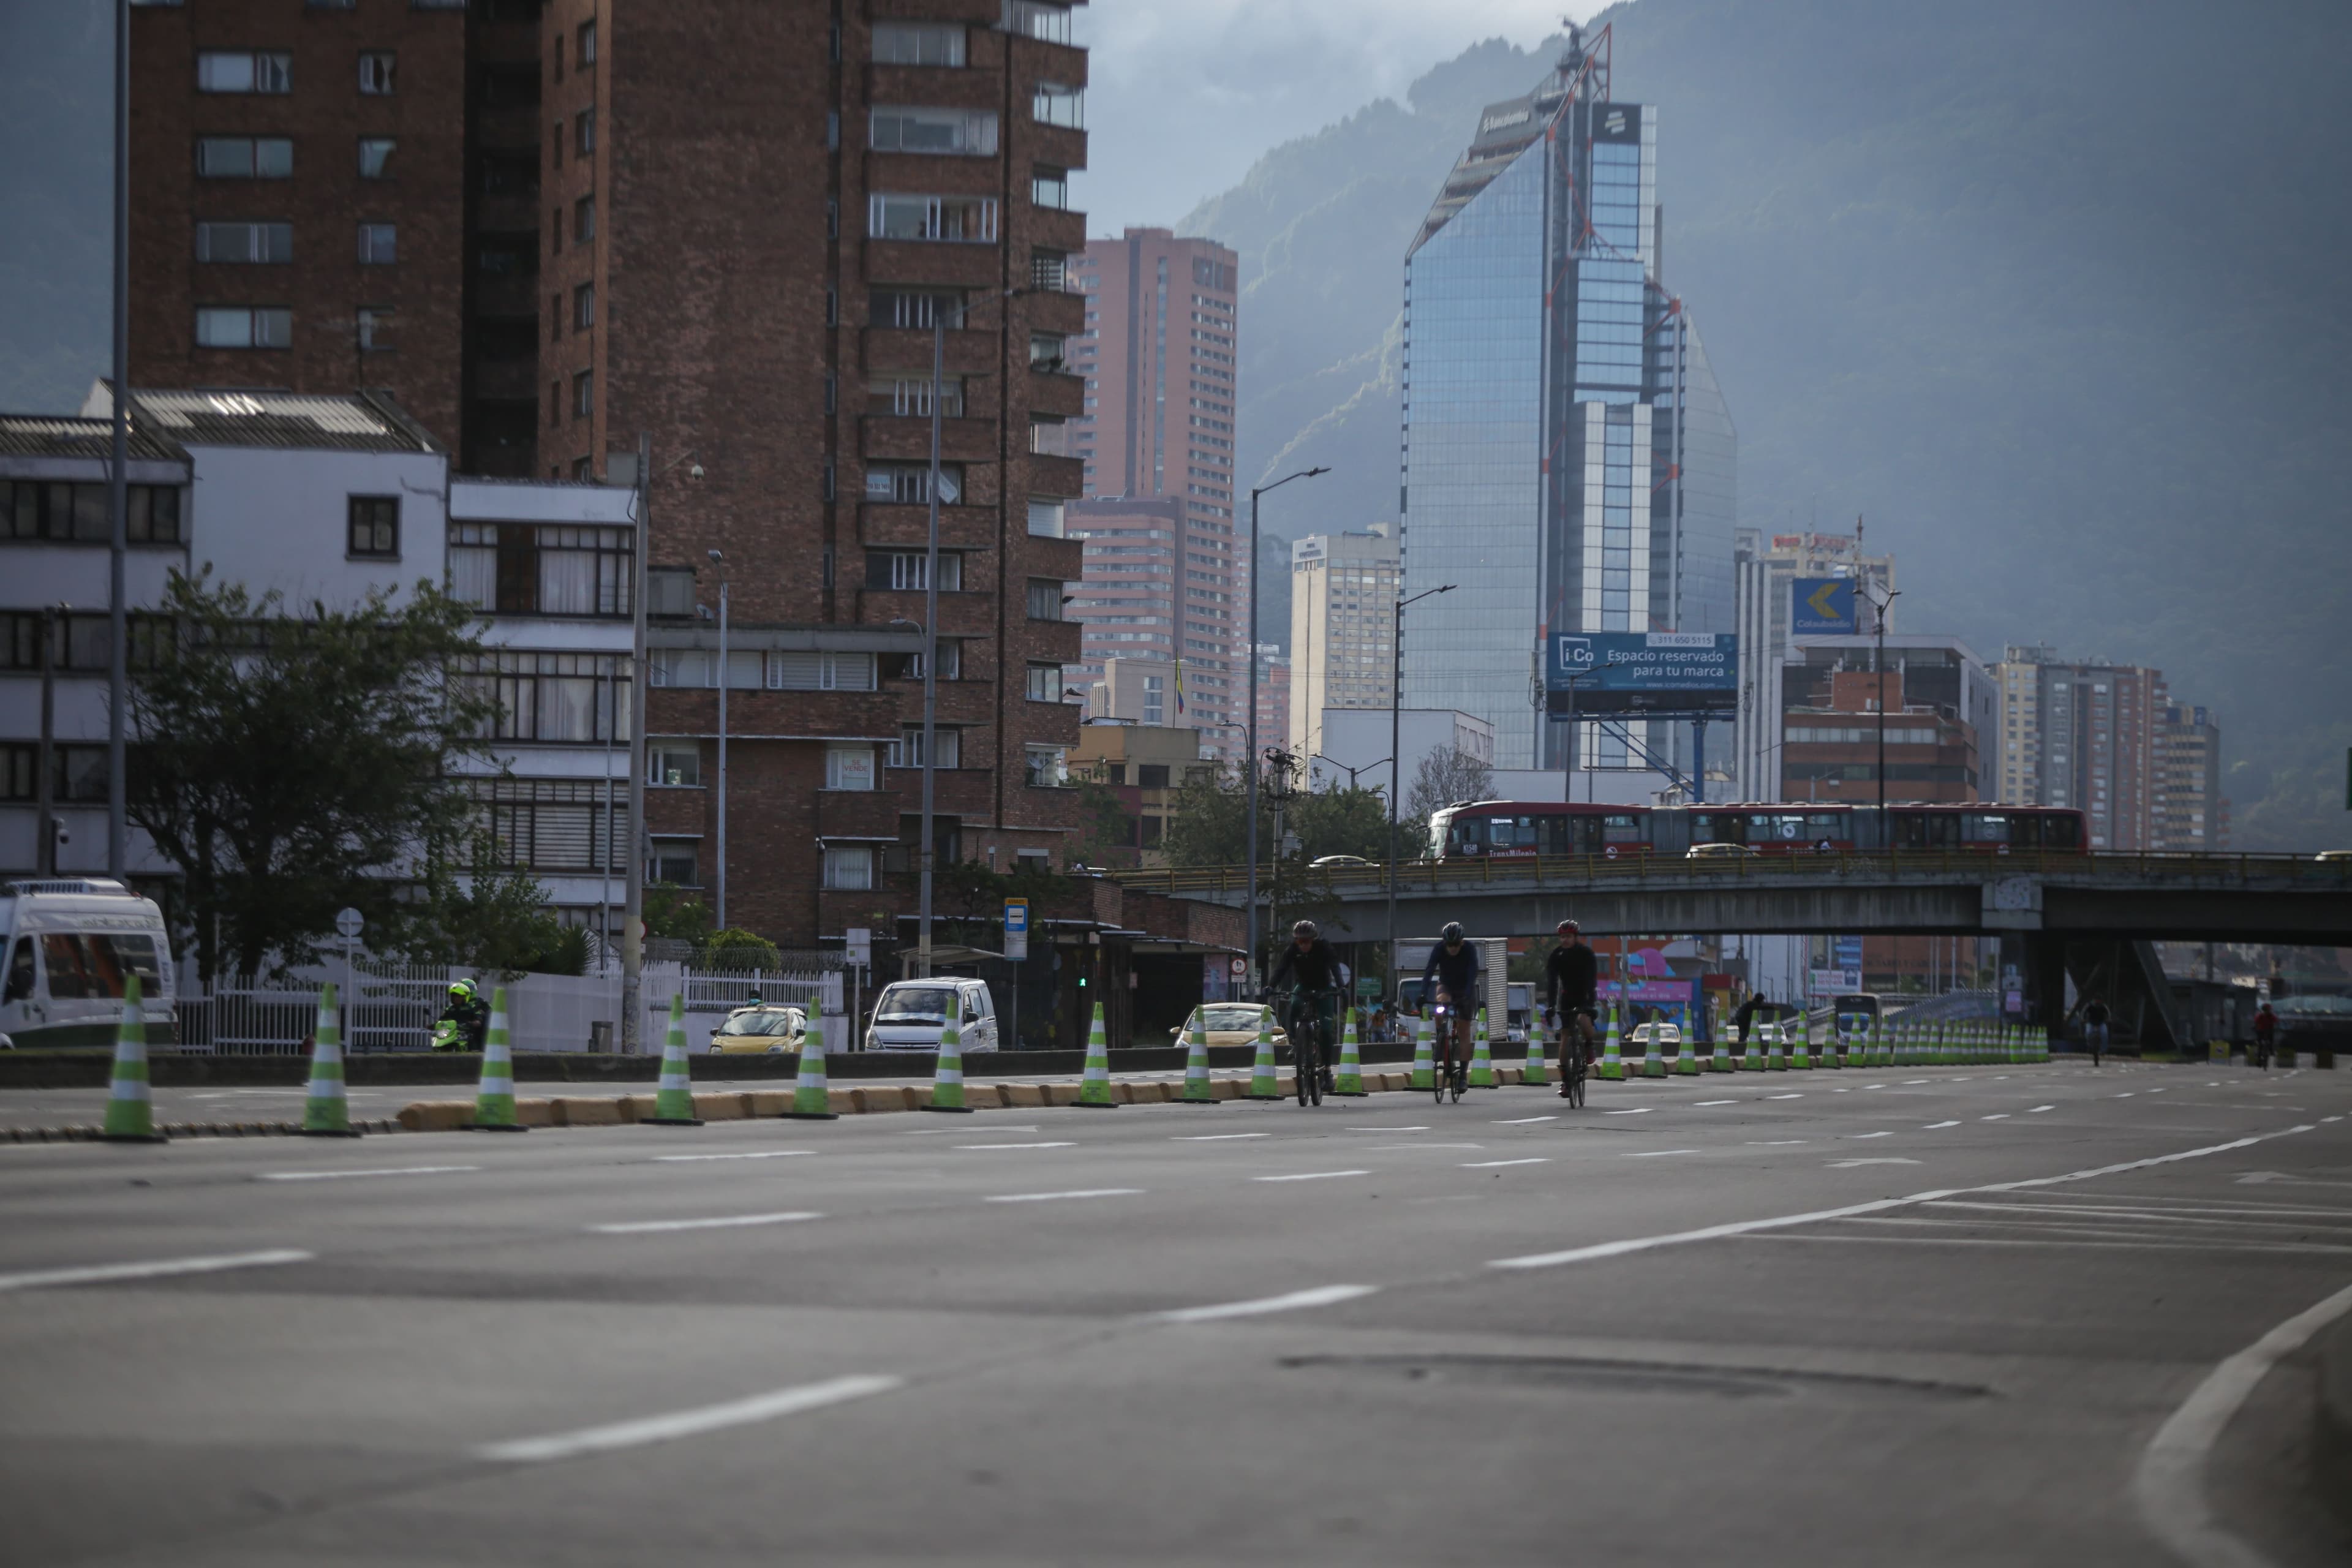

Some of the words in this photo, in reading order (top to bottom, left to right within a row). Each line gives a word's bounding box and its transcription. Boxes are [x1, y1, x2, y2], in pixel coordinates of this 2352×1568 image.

[1608, 649, 1656, 663] Espacio
[1659, 650, 1725, 662] reservado
[1634, 666, 1663, 679] para
[1666, 666, 1680, 676] tu
[1684, 667, 1725, 677] marca
